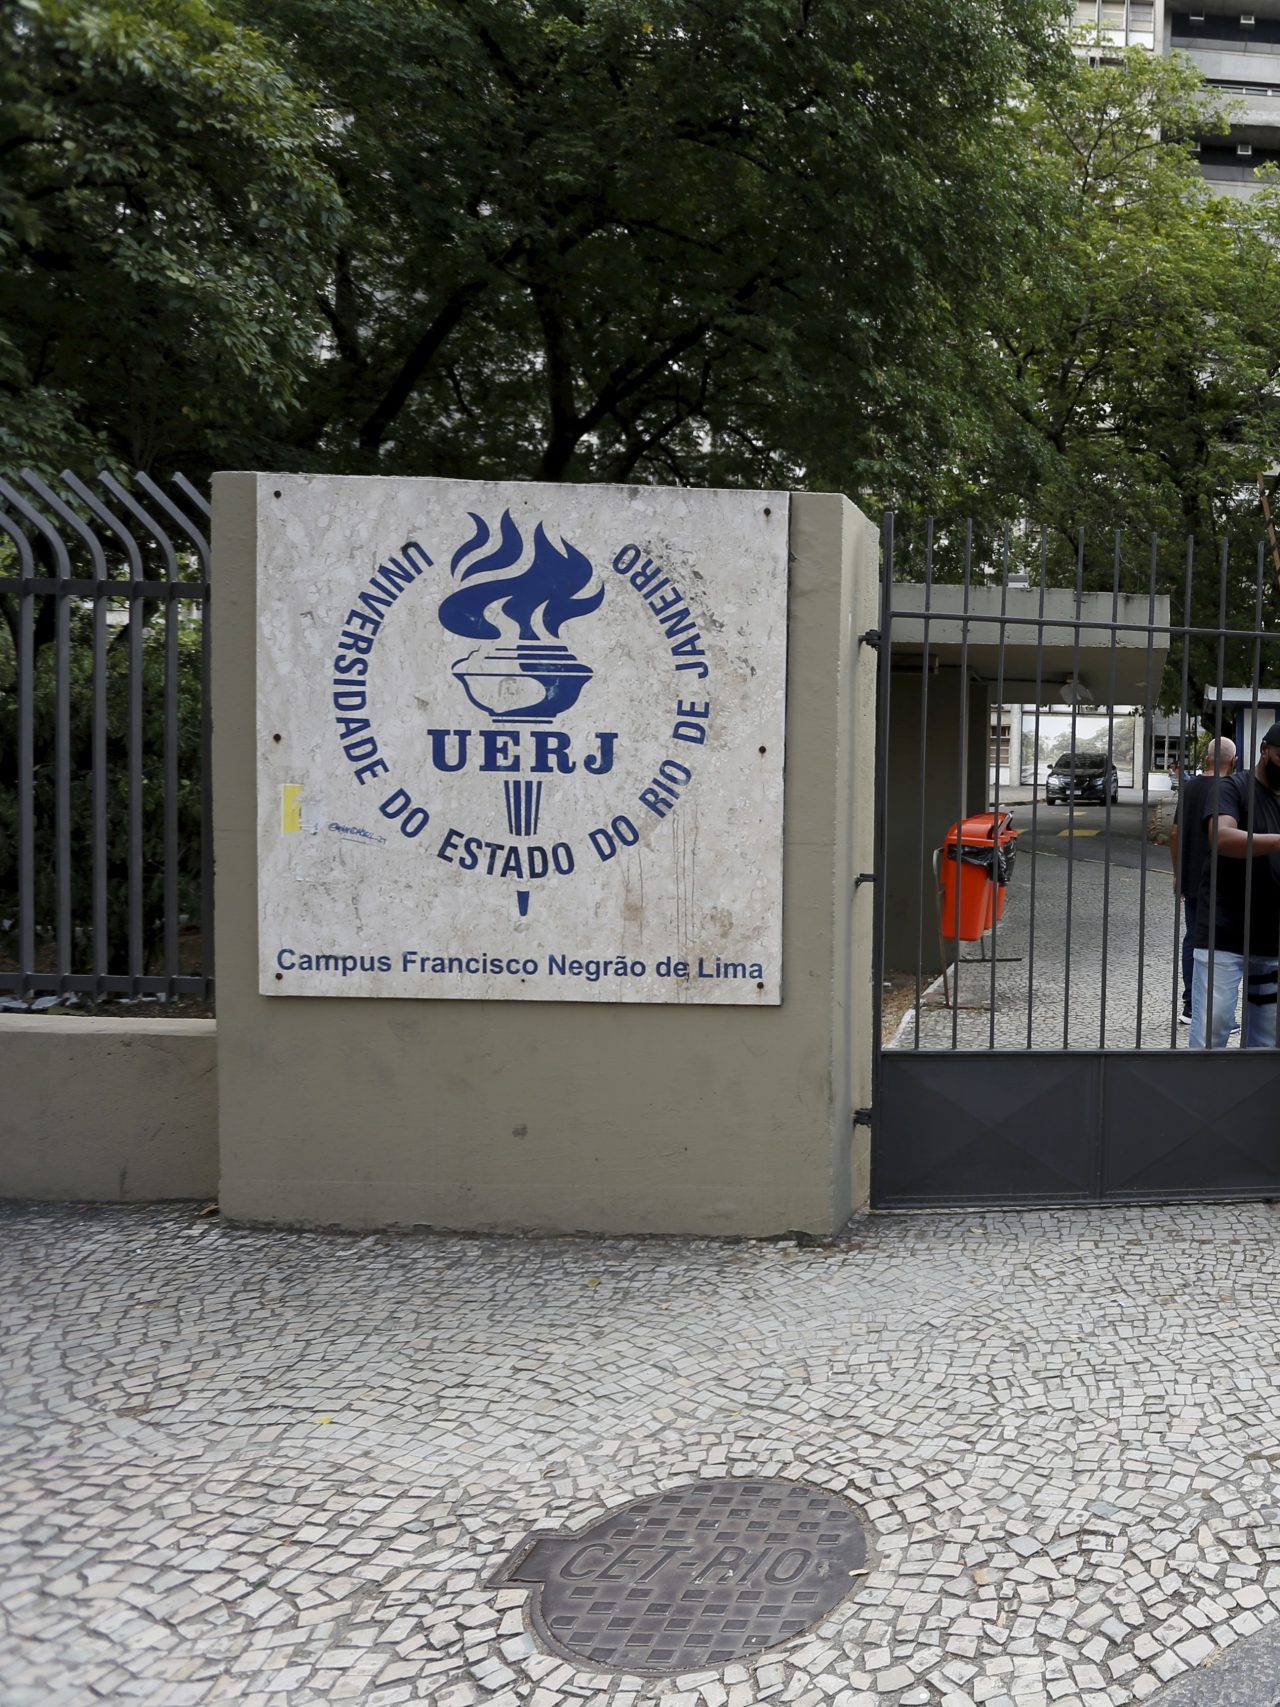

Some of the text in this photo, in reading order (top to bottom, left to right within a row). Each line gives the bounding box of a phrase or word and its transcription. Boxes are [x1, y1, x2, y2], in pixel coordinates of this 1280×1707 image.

[612, 543, 710, 680] JANEIRO
[333, 541, 434, 786] UNIVERSIDADE
[672, 698, 710, 745] DE
[427, 728, 619, 776] UERJ
[378, 787, 430, 838] DO
[638, 758, 693, 819] RIO
[437, 829, 576, 879] ESTADO
[588, 815, 641, 863] DO
[276, 948, 764, 982] Campus Francisco Negrão de Lima
[559, 1542, 813, 1586] CET-RIO
